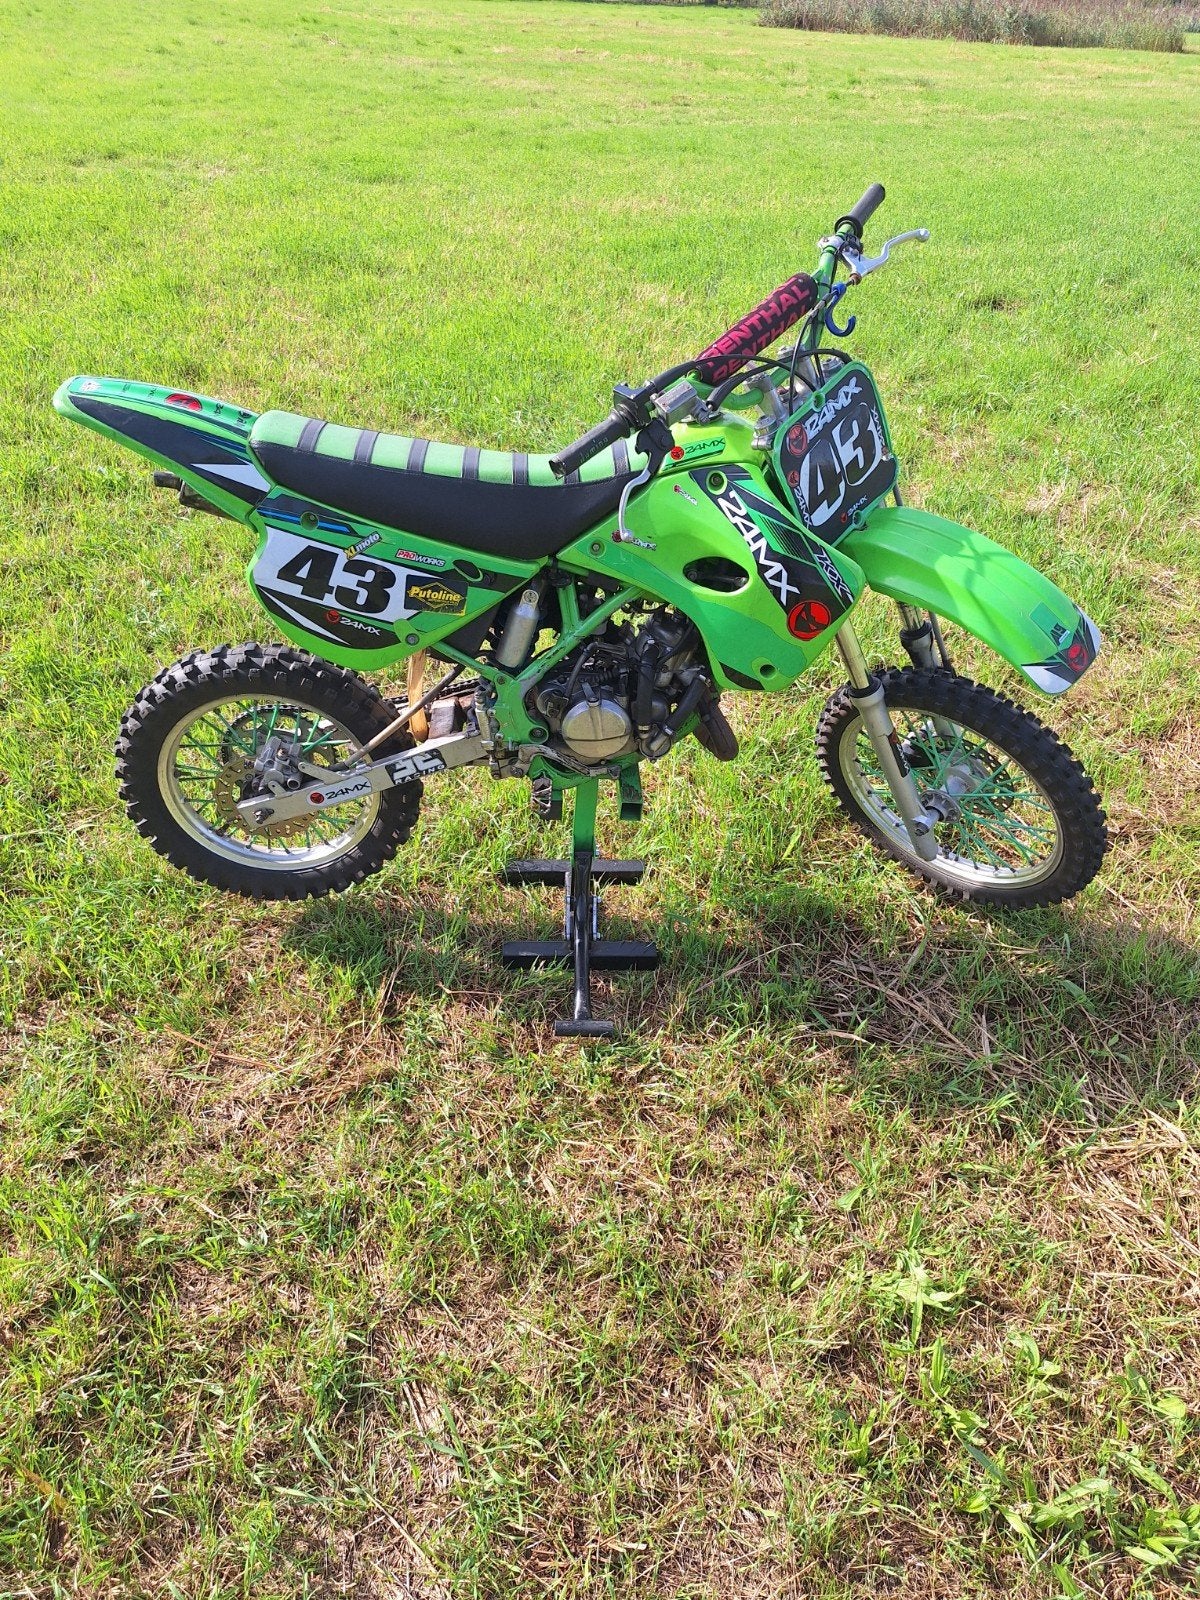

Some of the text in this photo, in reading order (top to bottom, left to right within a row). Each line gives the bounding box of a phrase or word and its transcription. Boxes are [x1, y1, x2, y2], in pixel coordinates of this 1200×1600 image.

[803, 376, 863, 440] 24MX
[684, 437, 725, 454] 24MX
[800, 402, 883, 527] 43
[717, 490, 801, 607] 24MX
[276, 544, 397, 615] 43
[408, 584, 462, 602] Putoline
[339, 616, 382, 636] 24MX
[325, 780, 371, 800] 24MX
